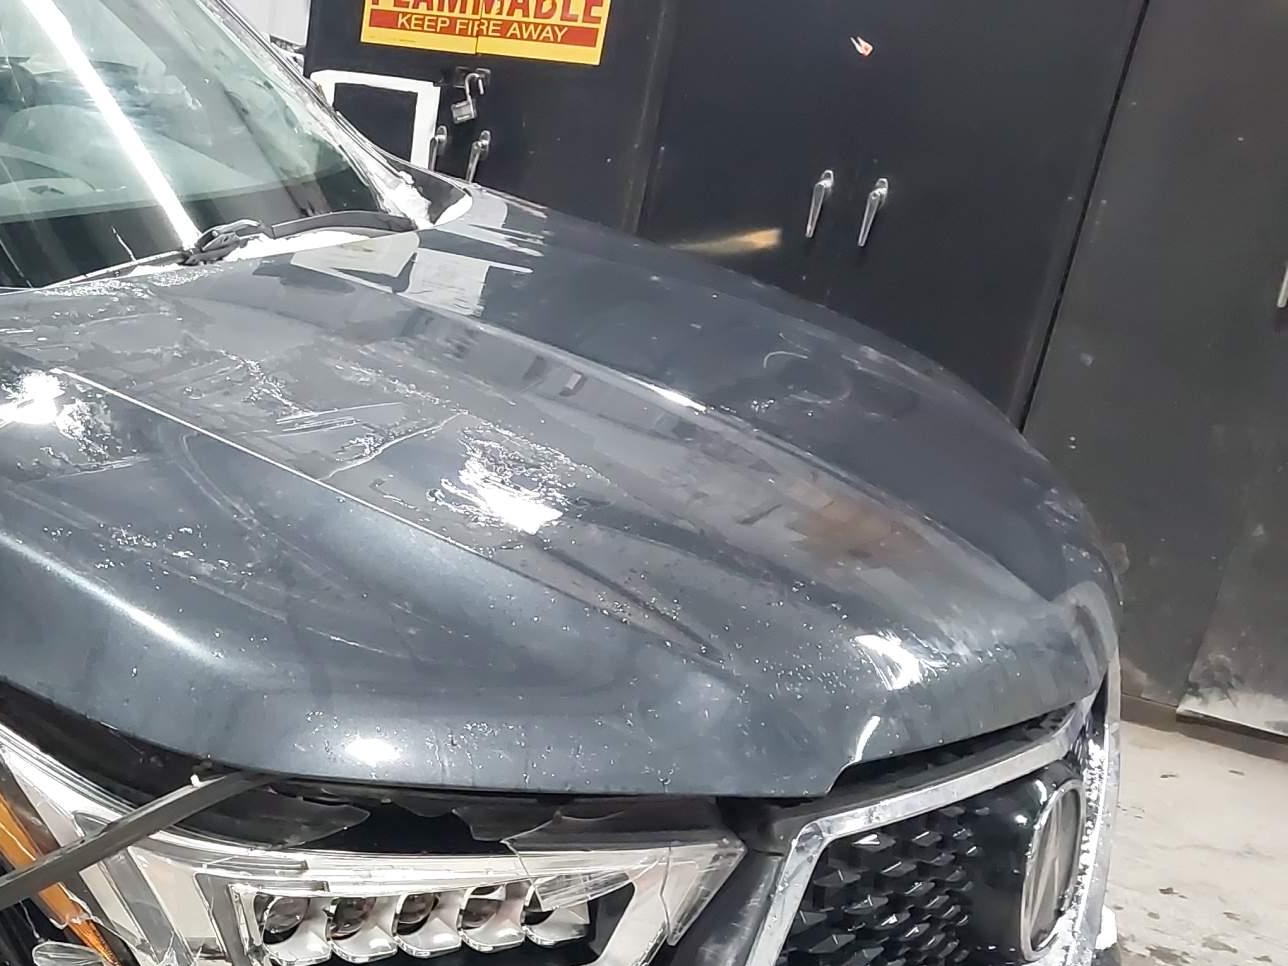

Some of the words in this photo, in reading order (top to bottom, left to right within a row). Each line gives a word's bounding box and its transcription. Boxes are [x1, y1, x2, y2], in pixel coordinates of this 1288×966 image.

[397, 13, 450, 33] KEEP
[455, 19, 503, 37] FIRE
[506, 22, 569, 43] AWAY
